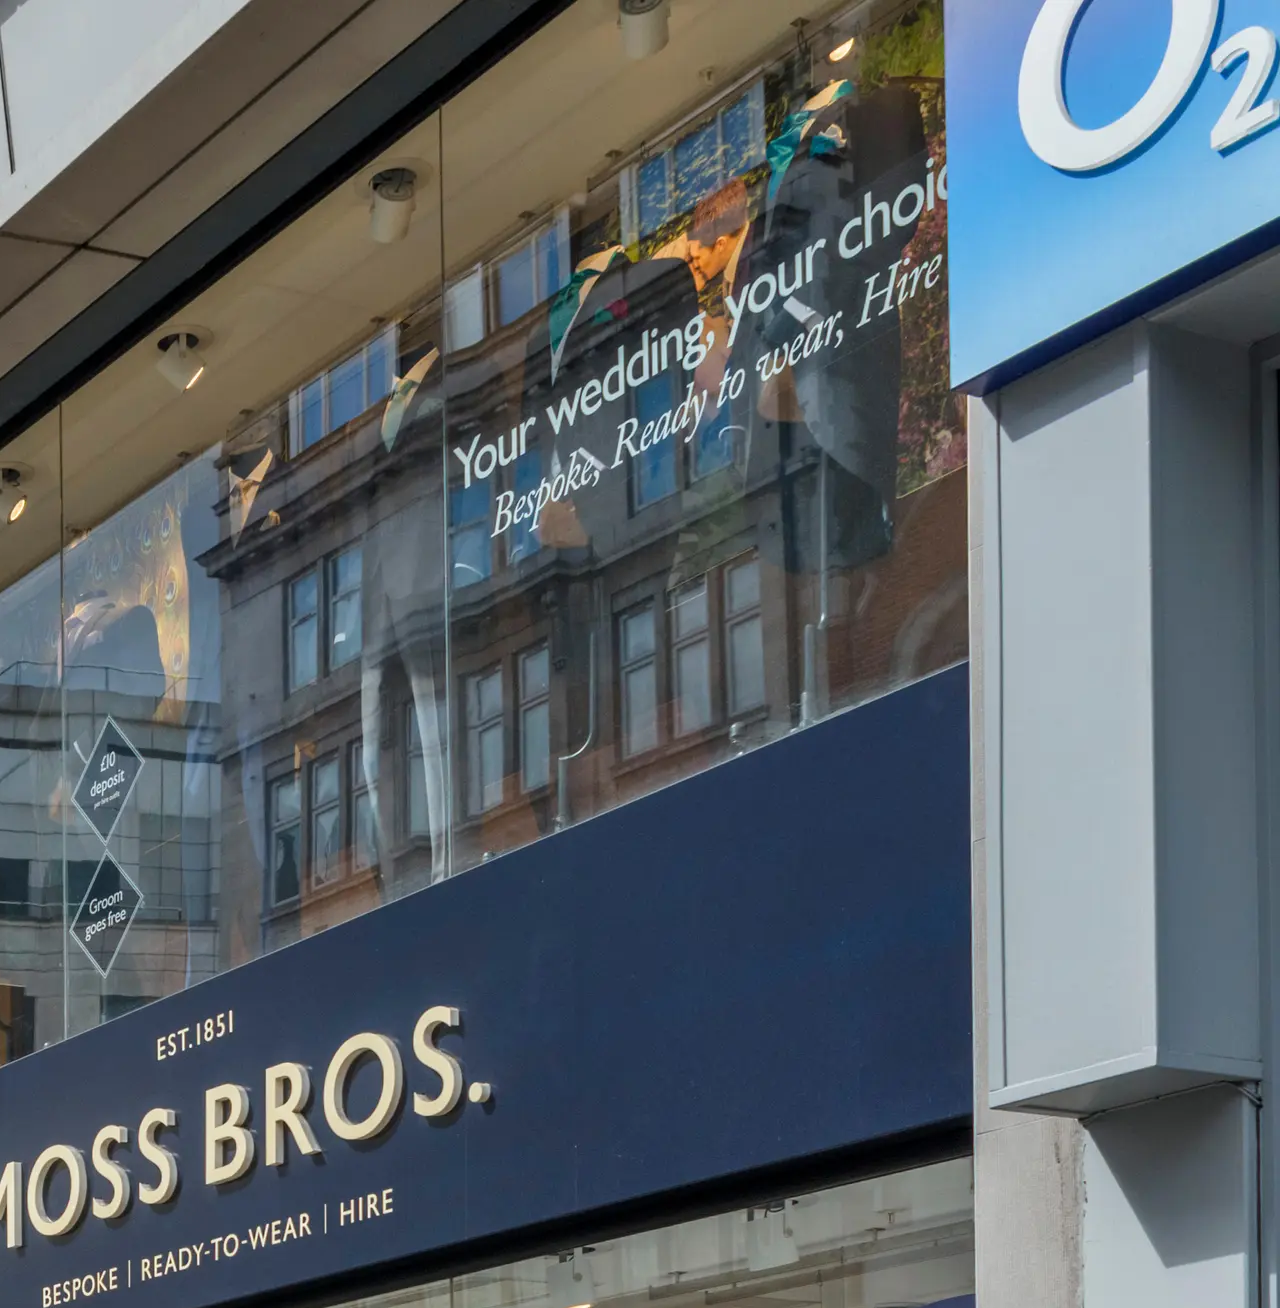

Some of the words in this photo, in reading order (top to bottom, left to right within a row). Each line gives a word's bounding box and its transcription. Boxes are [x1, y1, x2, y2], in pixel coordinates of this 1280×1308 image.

[453, 415, 536, 489] Your
[546, 311, 715, 435] wedding,
[724, 238, 826, 348] your
[838, 157, 948, 260] choi
[490, 450, 600, 538] Bespoke,
[611, 381, 707, 469] Ready
[717, 368, 745, 409] to
[755, 310, 843, 382] wear,
[856, 254, 943, 329] Hire
[90, 769, 126, 797] deposit
[100, 751, 116, 773] £10
[85, 917, 106, 942] goes
[107, 908, 127, 927] free
[89, 890, 123, 915] Groom
[156, 1010, 234, 1061] EST.1851
[205, 1006, 492, 1186] BROS.
[42, 1267, 119, 1308] BESPOKE
[141, 1213, 312, 1282] READY-TO-WEAR
[340, 1188, 395, 1227] HIRE
